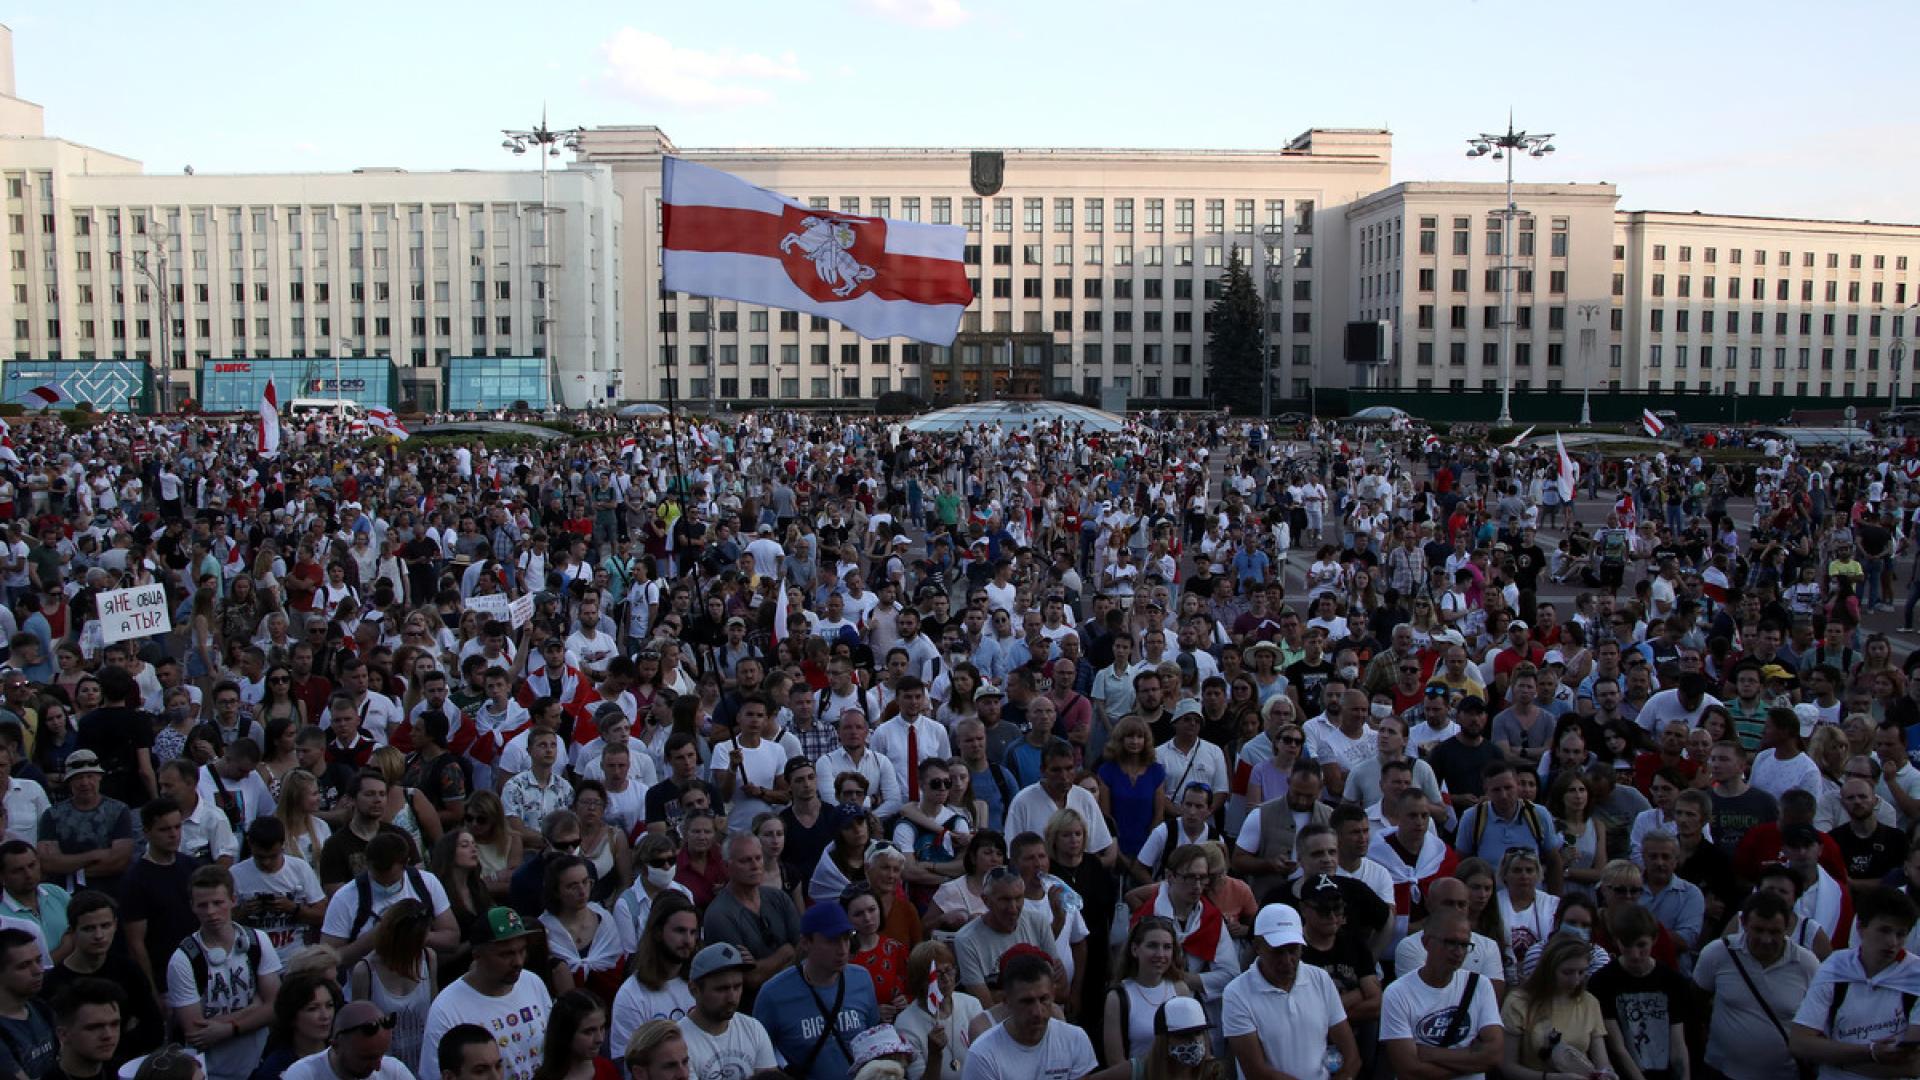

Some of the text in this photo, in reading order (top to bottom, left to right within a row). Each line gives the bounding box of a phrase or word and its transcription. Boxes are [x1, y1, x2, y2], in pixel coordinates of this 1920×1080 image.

[130, 611, 162, 630] ТЫ?
[801, 1009, 861, 1040] BIG TAR
